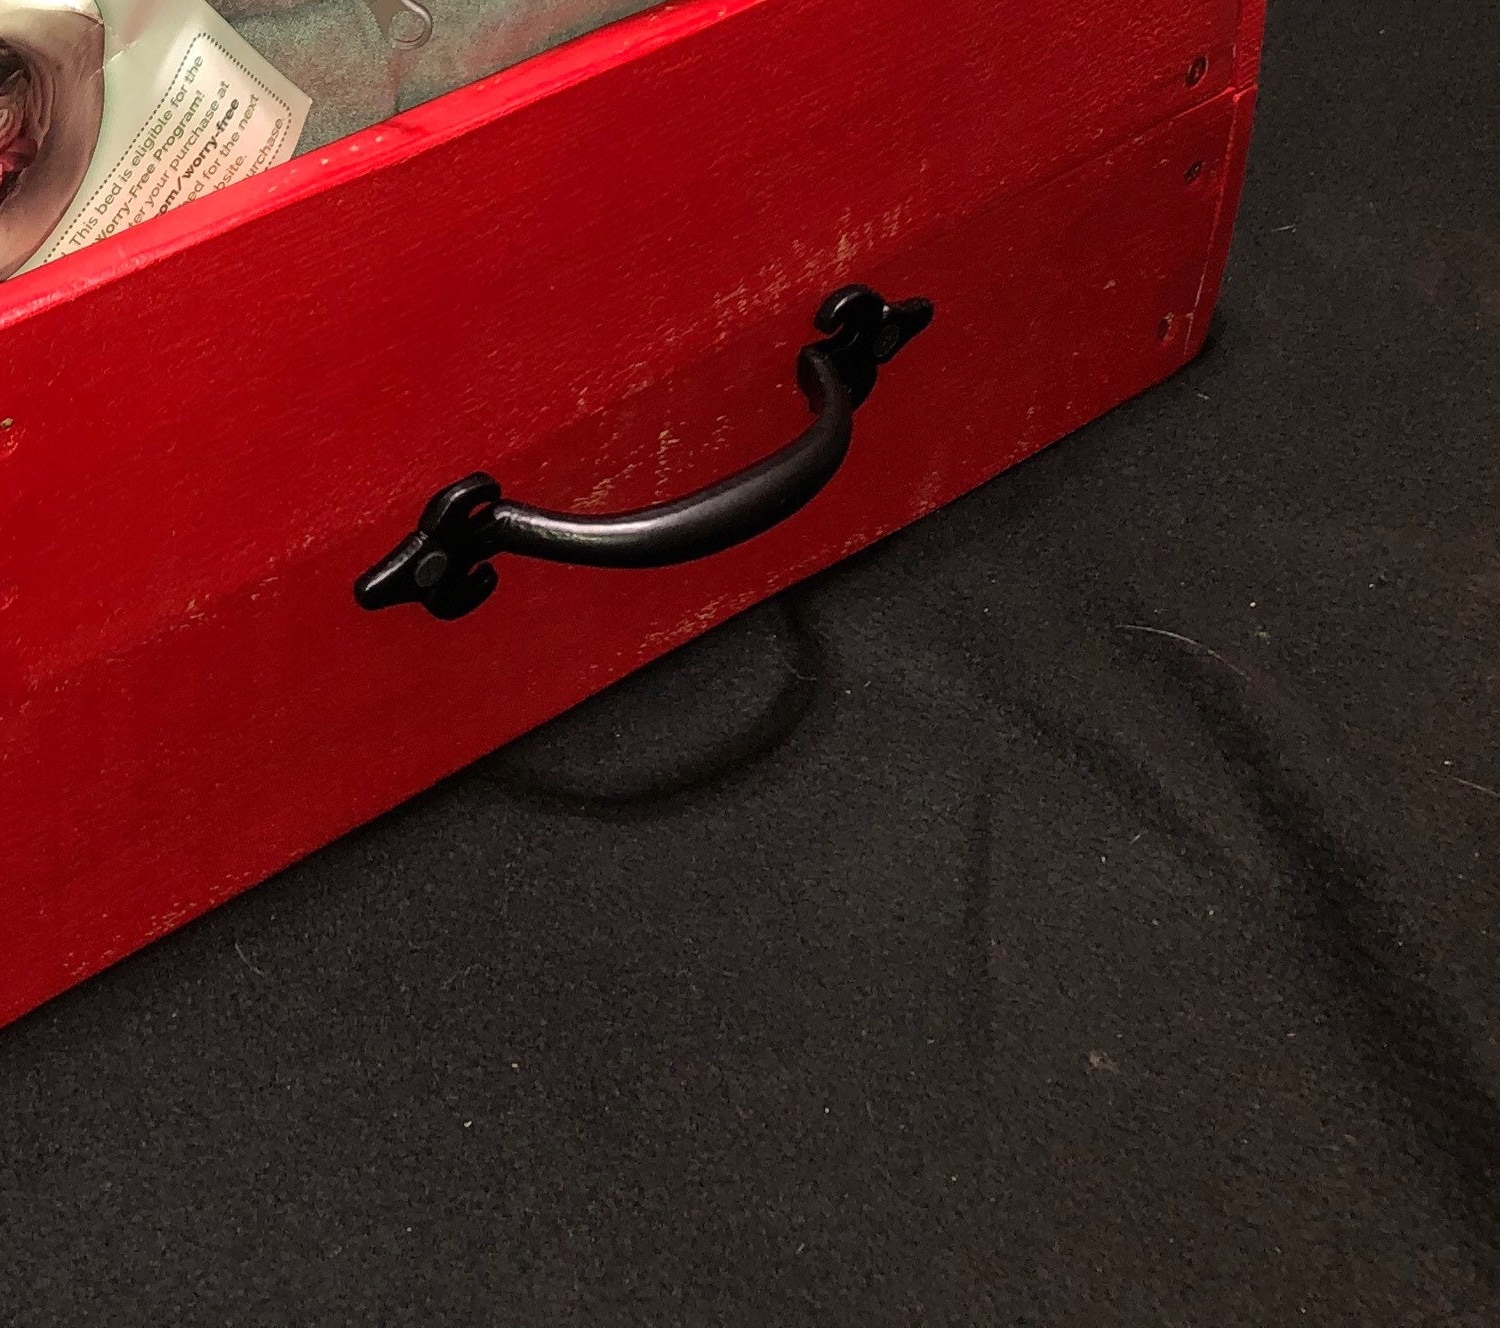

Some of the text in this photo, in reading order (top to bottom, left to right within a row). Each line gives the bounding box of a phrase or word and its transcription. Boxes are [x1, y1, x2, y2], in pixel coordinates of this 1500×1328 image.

[68, 55, 204, 246] This bed is eligible for the
[145, 170, 170, 208] your
[169, 99, 220, 172] purchase
[217, 80, 230, 100] at
[153, 89, 206, 162] Program!
[202, 158, 222, 180] for
[219, 132, 240, 158] the
[239, 93, 260, 131] next
